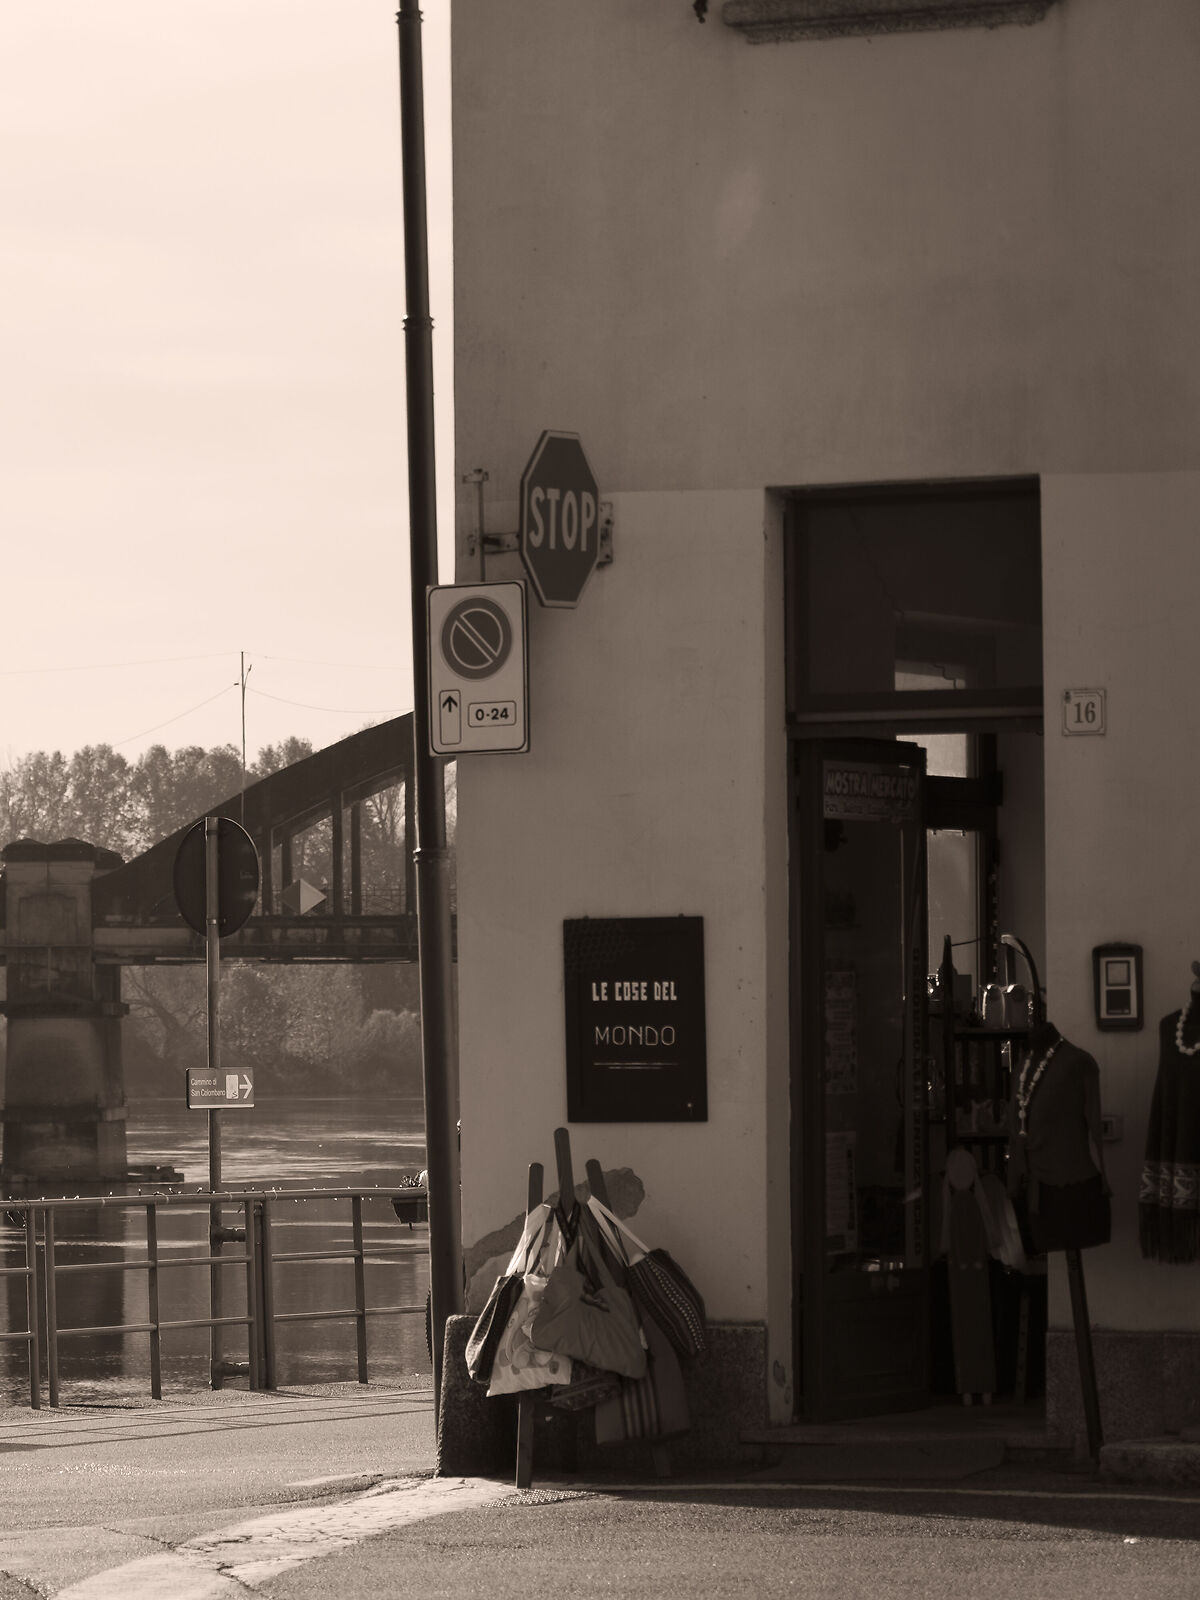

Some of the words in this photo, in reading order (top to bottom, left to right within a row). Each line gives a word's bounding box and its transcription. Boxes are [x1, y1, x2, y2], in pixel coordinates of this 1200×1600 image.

[529, 486, 596, 552] STOP
[475, 707, 509, 721] 0-24
[1074, 701, 1096, 723] 16
[825, 771, 868, 795] MOSTRA
[592, 982, 608, 1001] LE
[614, 981, 648, 1001] COSE
[654, 981, 677, 1001] DEL
[595, 1026, 675, 1046] MONDO
[191, 1088, 201, 1097] San
[201, 1088, 226, 1097] Colombano
